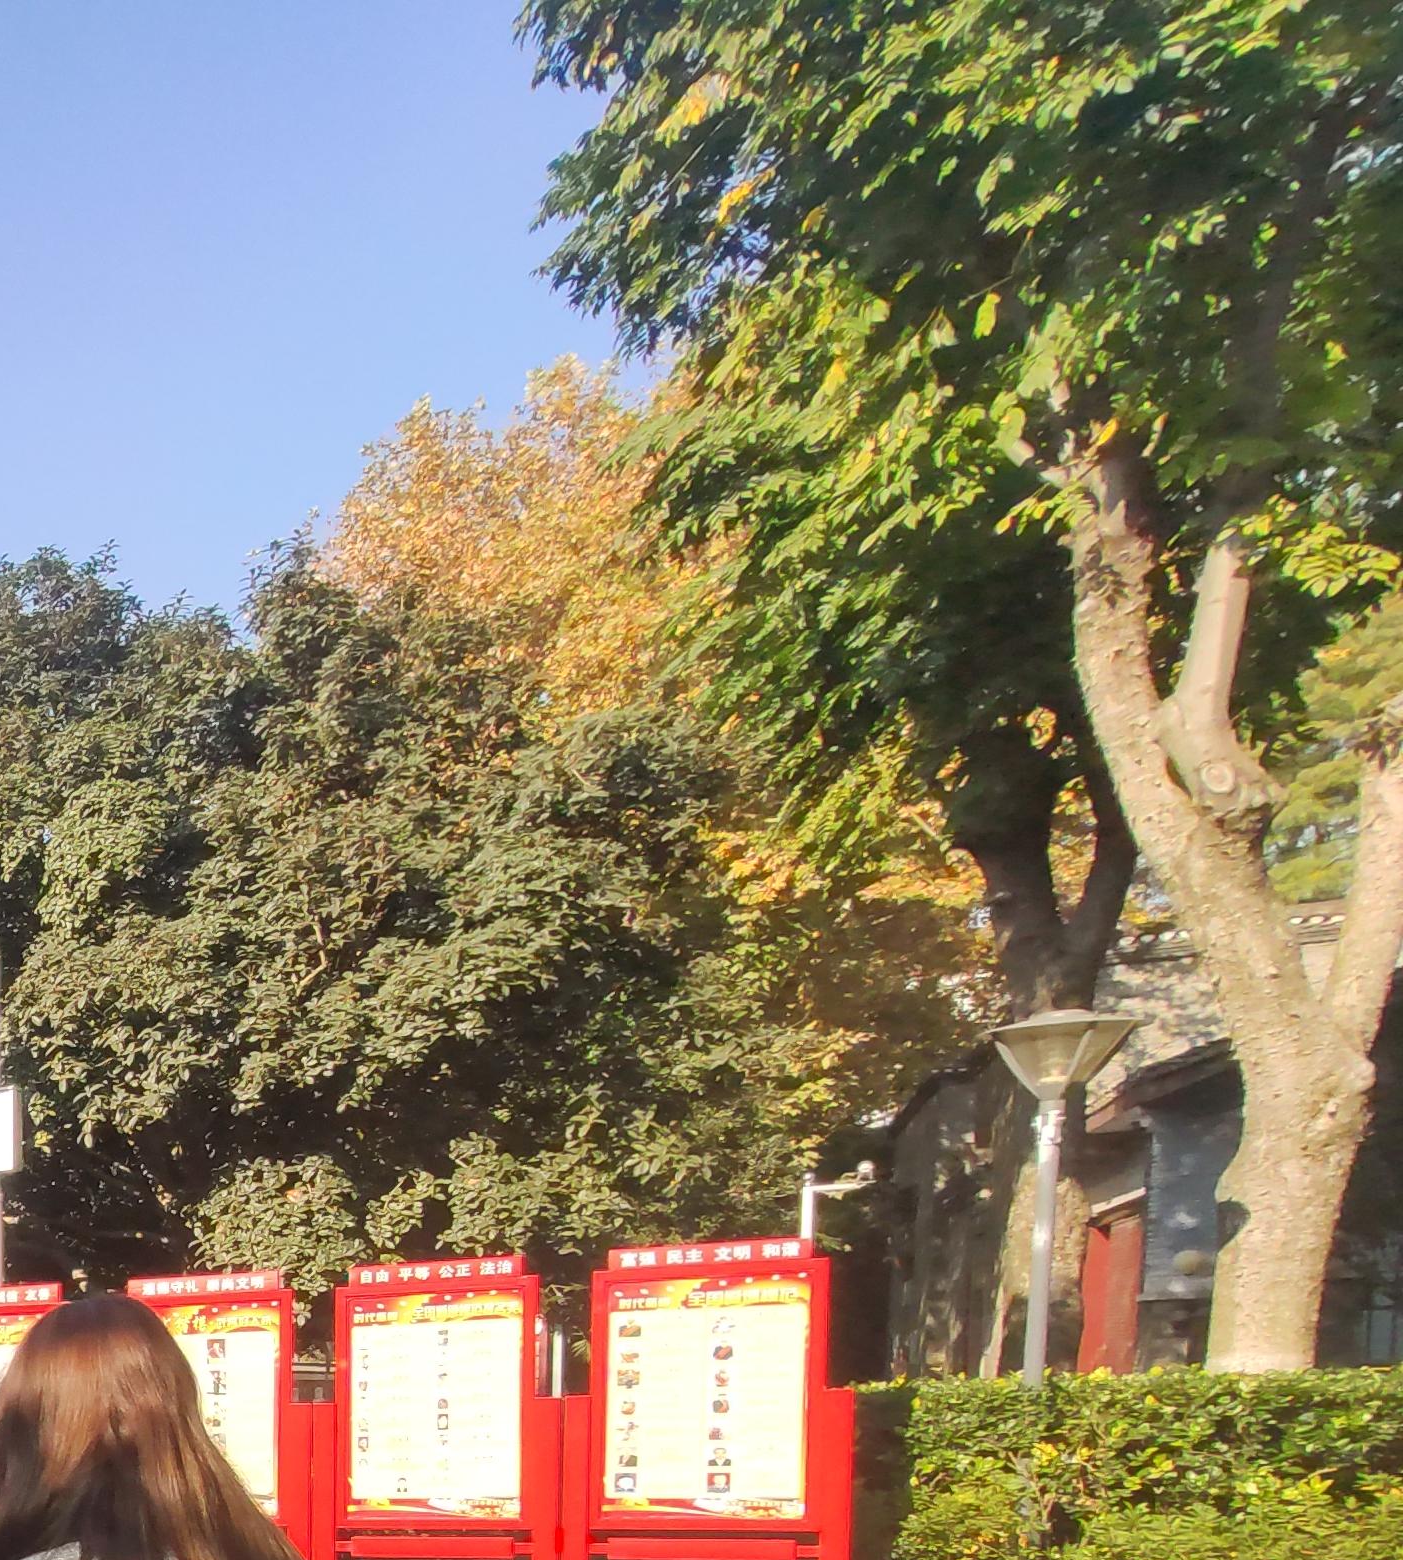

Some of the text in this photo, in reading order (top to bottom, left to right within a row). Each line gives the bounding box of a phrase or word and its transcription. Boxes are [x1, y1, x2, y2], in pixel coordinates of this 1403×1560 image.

[620, 1242, 800, 1267] 富强 民主 文明 和谐
[360, 1260, 513, 1284] 自由 平等 公正 法治
[25, 1288, 50, 1301] 友善
